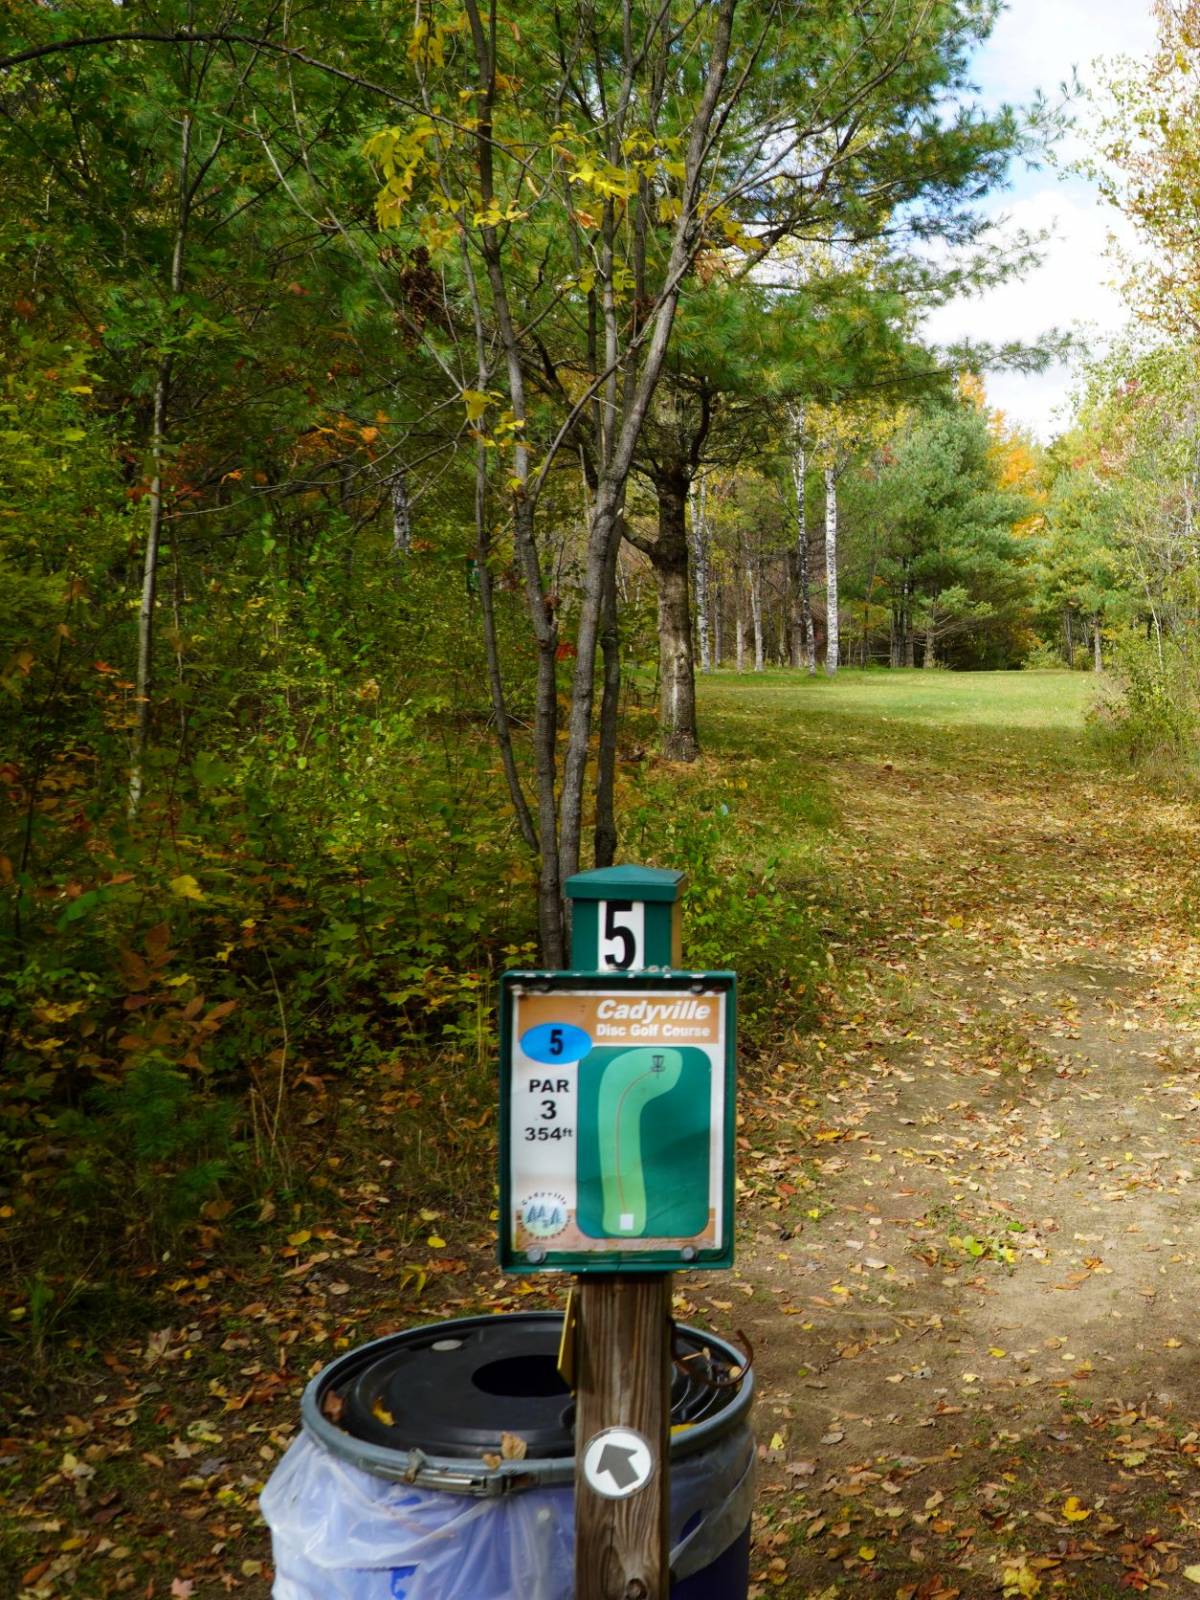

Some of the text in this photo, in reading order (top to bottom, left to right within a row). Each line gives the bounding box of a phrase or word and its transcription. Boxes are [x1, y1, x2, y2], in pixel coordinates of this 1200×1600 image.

[604, 901, 636, 971] 5
[596, 1000, 710, 1024] Cadyville
[596, 1023, 710, 1037] Disc Golf Course
[550, 1029, 564, 1056] 5
[529, 1079, 569, 1093] PAR
[541, 1100, 557, 1120] 3
[525, 1127, 573, 1141] 354ft
